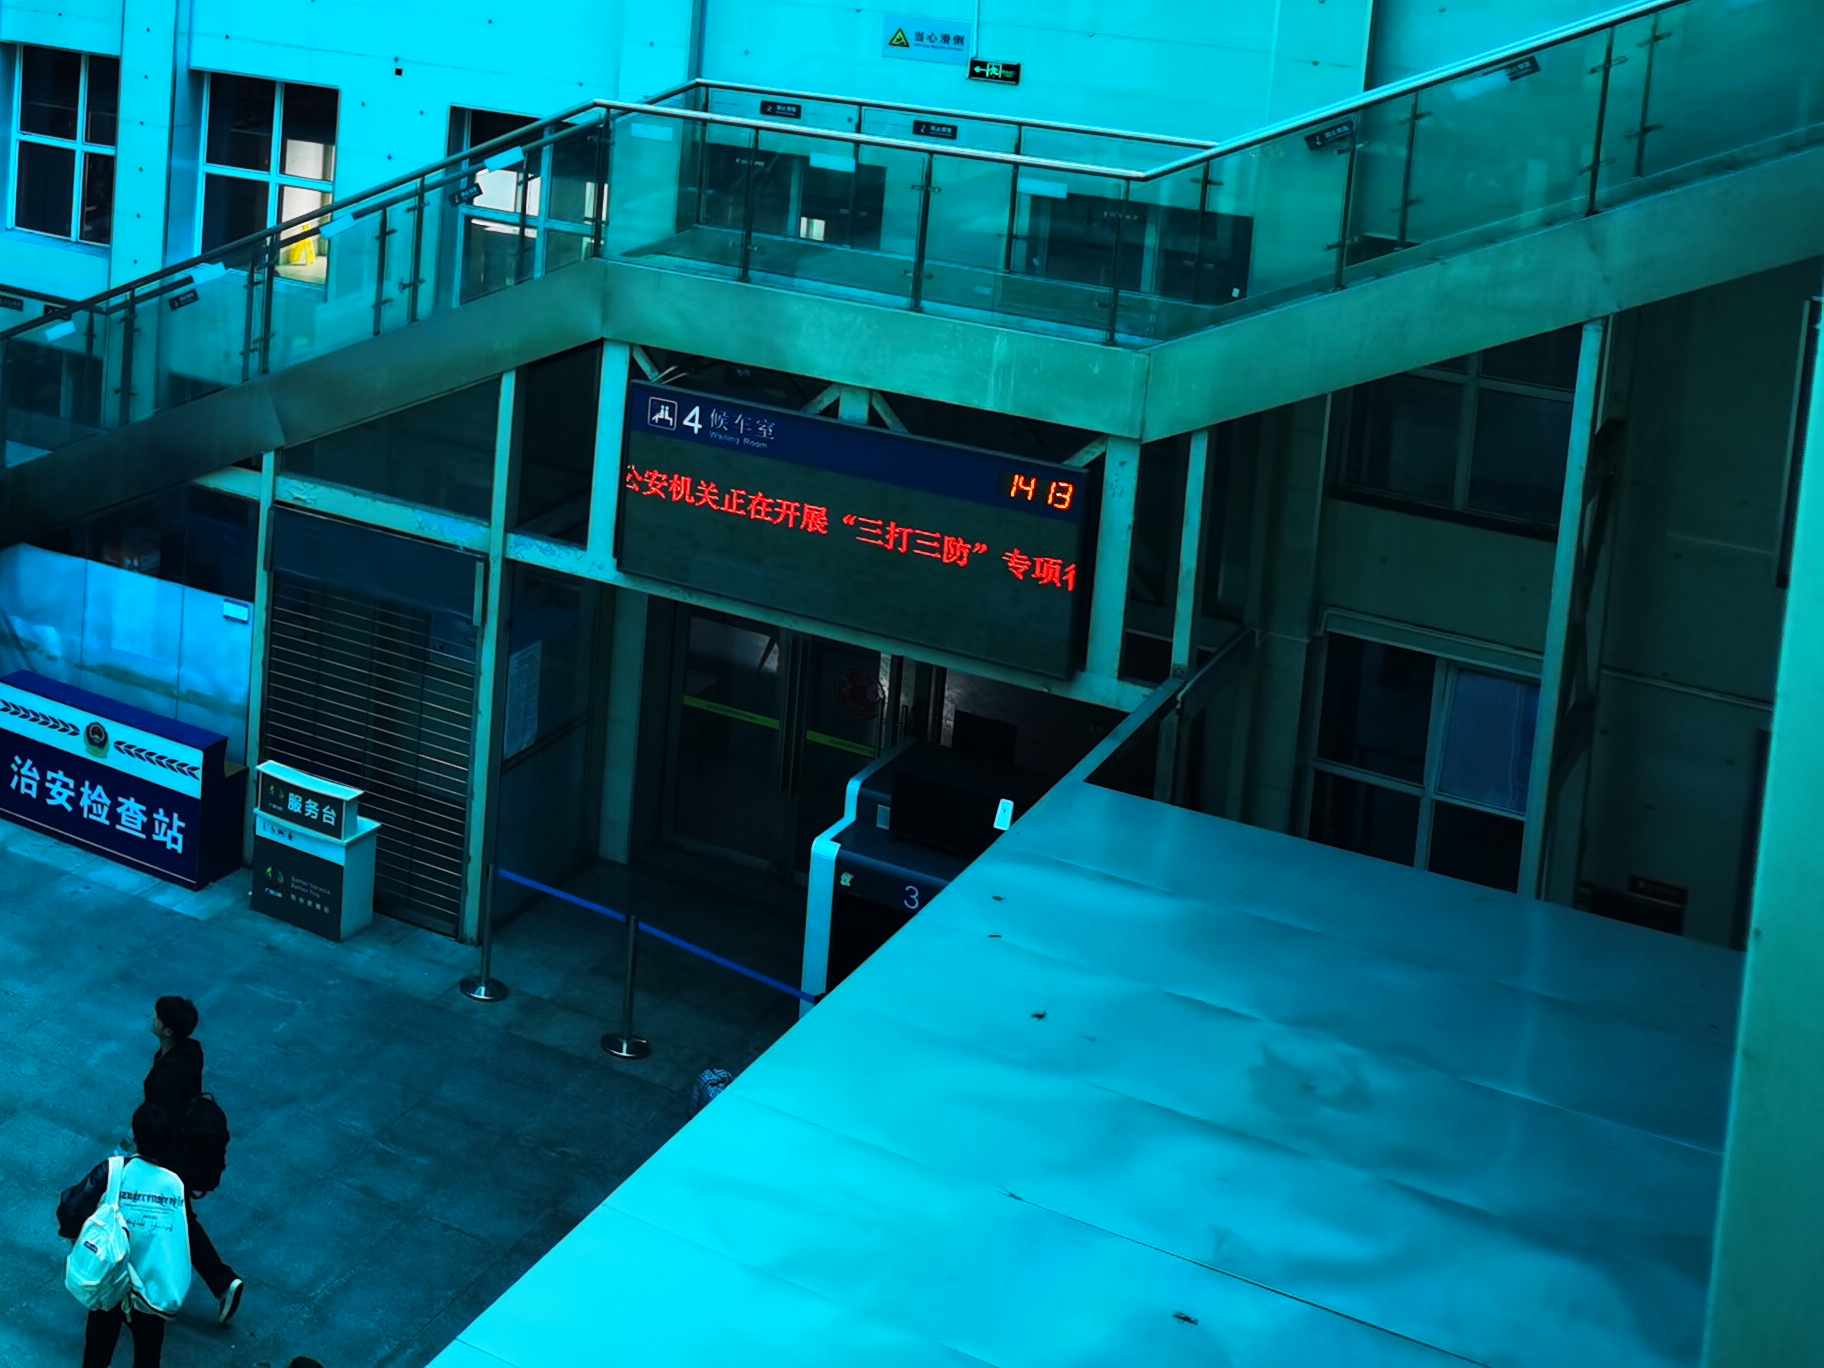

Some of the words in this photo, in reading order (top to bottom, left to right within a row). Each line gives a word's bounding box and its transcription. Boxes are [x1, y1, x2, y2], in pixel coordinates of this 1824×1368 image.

[914, 31, 965, 46] 当心滑倒
[743, 437, 768, 450] Room
[9, 754, 186, 855] 治安检查站
[287, 792, 337, 826] 服务台
[903, 884, 920, 910] 3
